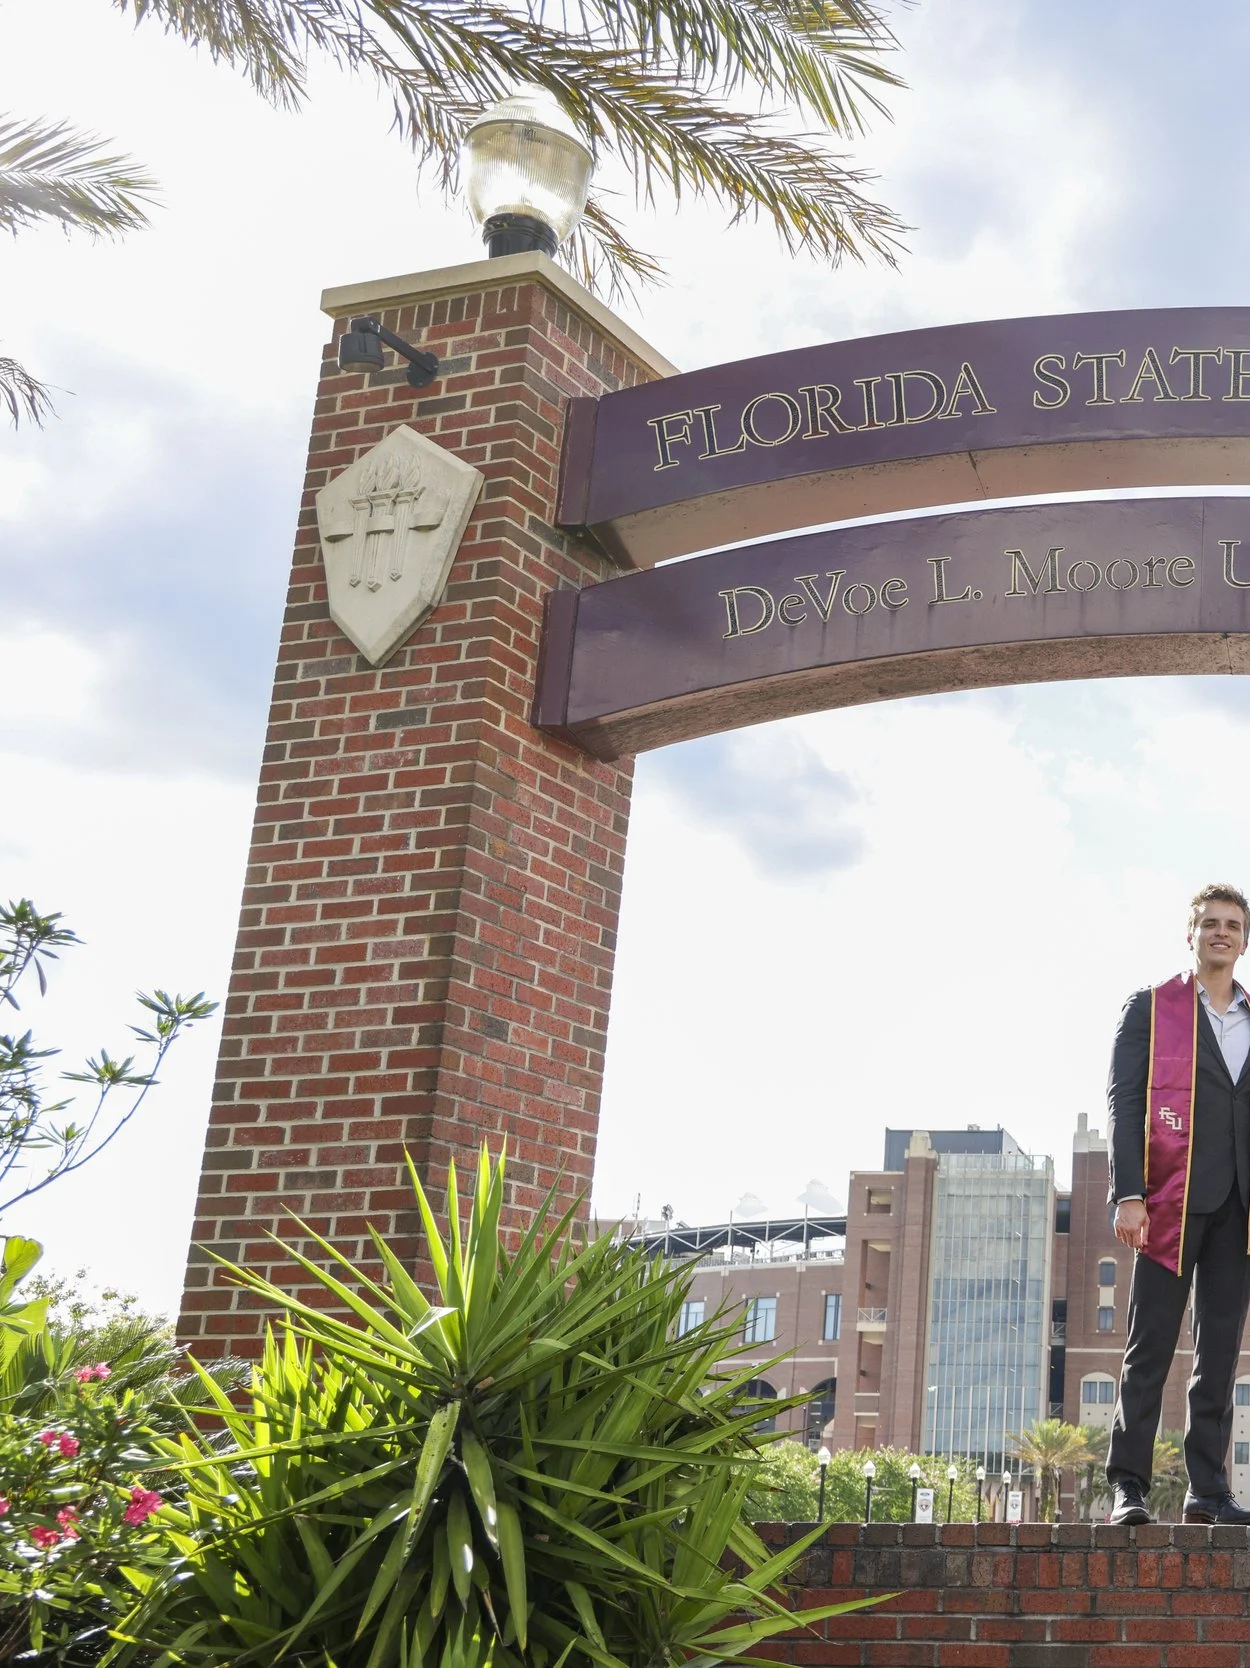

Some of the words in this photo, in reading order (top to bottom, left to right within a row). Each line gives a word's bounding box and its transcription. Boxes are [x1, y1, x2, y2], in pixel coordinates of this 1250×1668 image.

[646, 363, 996, 471] FLORIDA
[718, 569, 909, 639] DeVoe
[927, 556, 983, 605] L.
[1004, 546, 1195, 597] Moore
[1159, 1106, 1182, 1130] FSU
